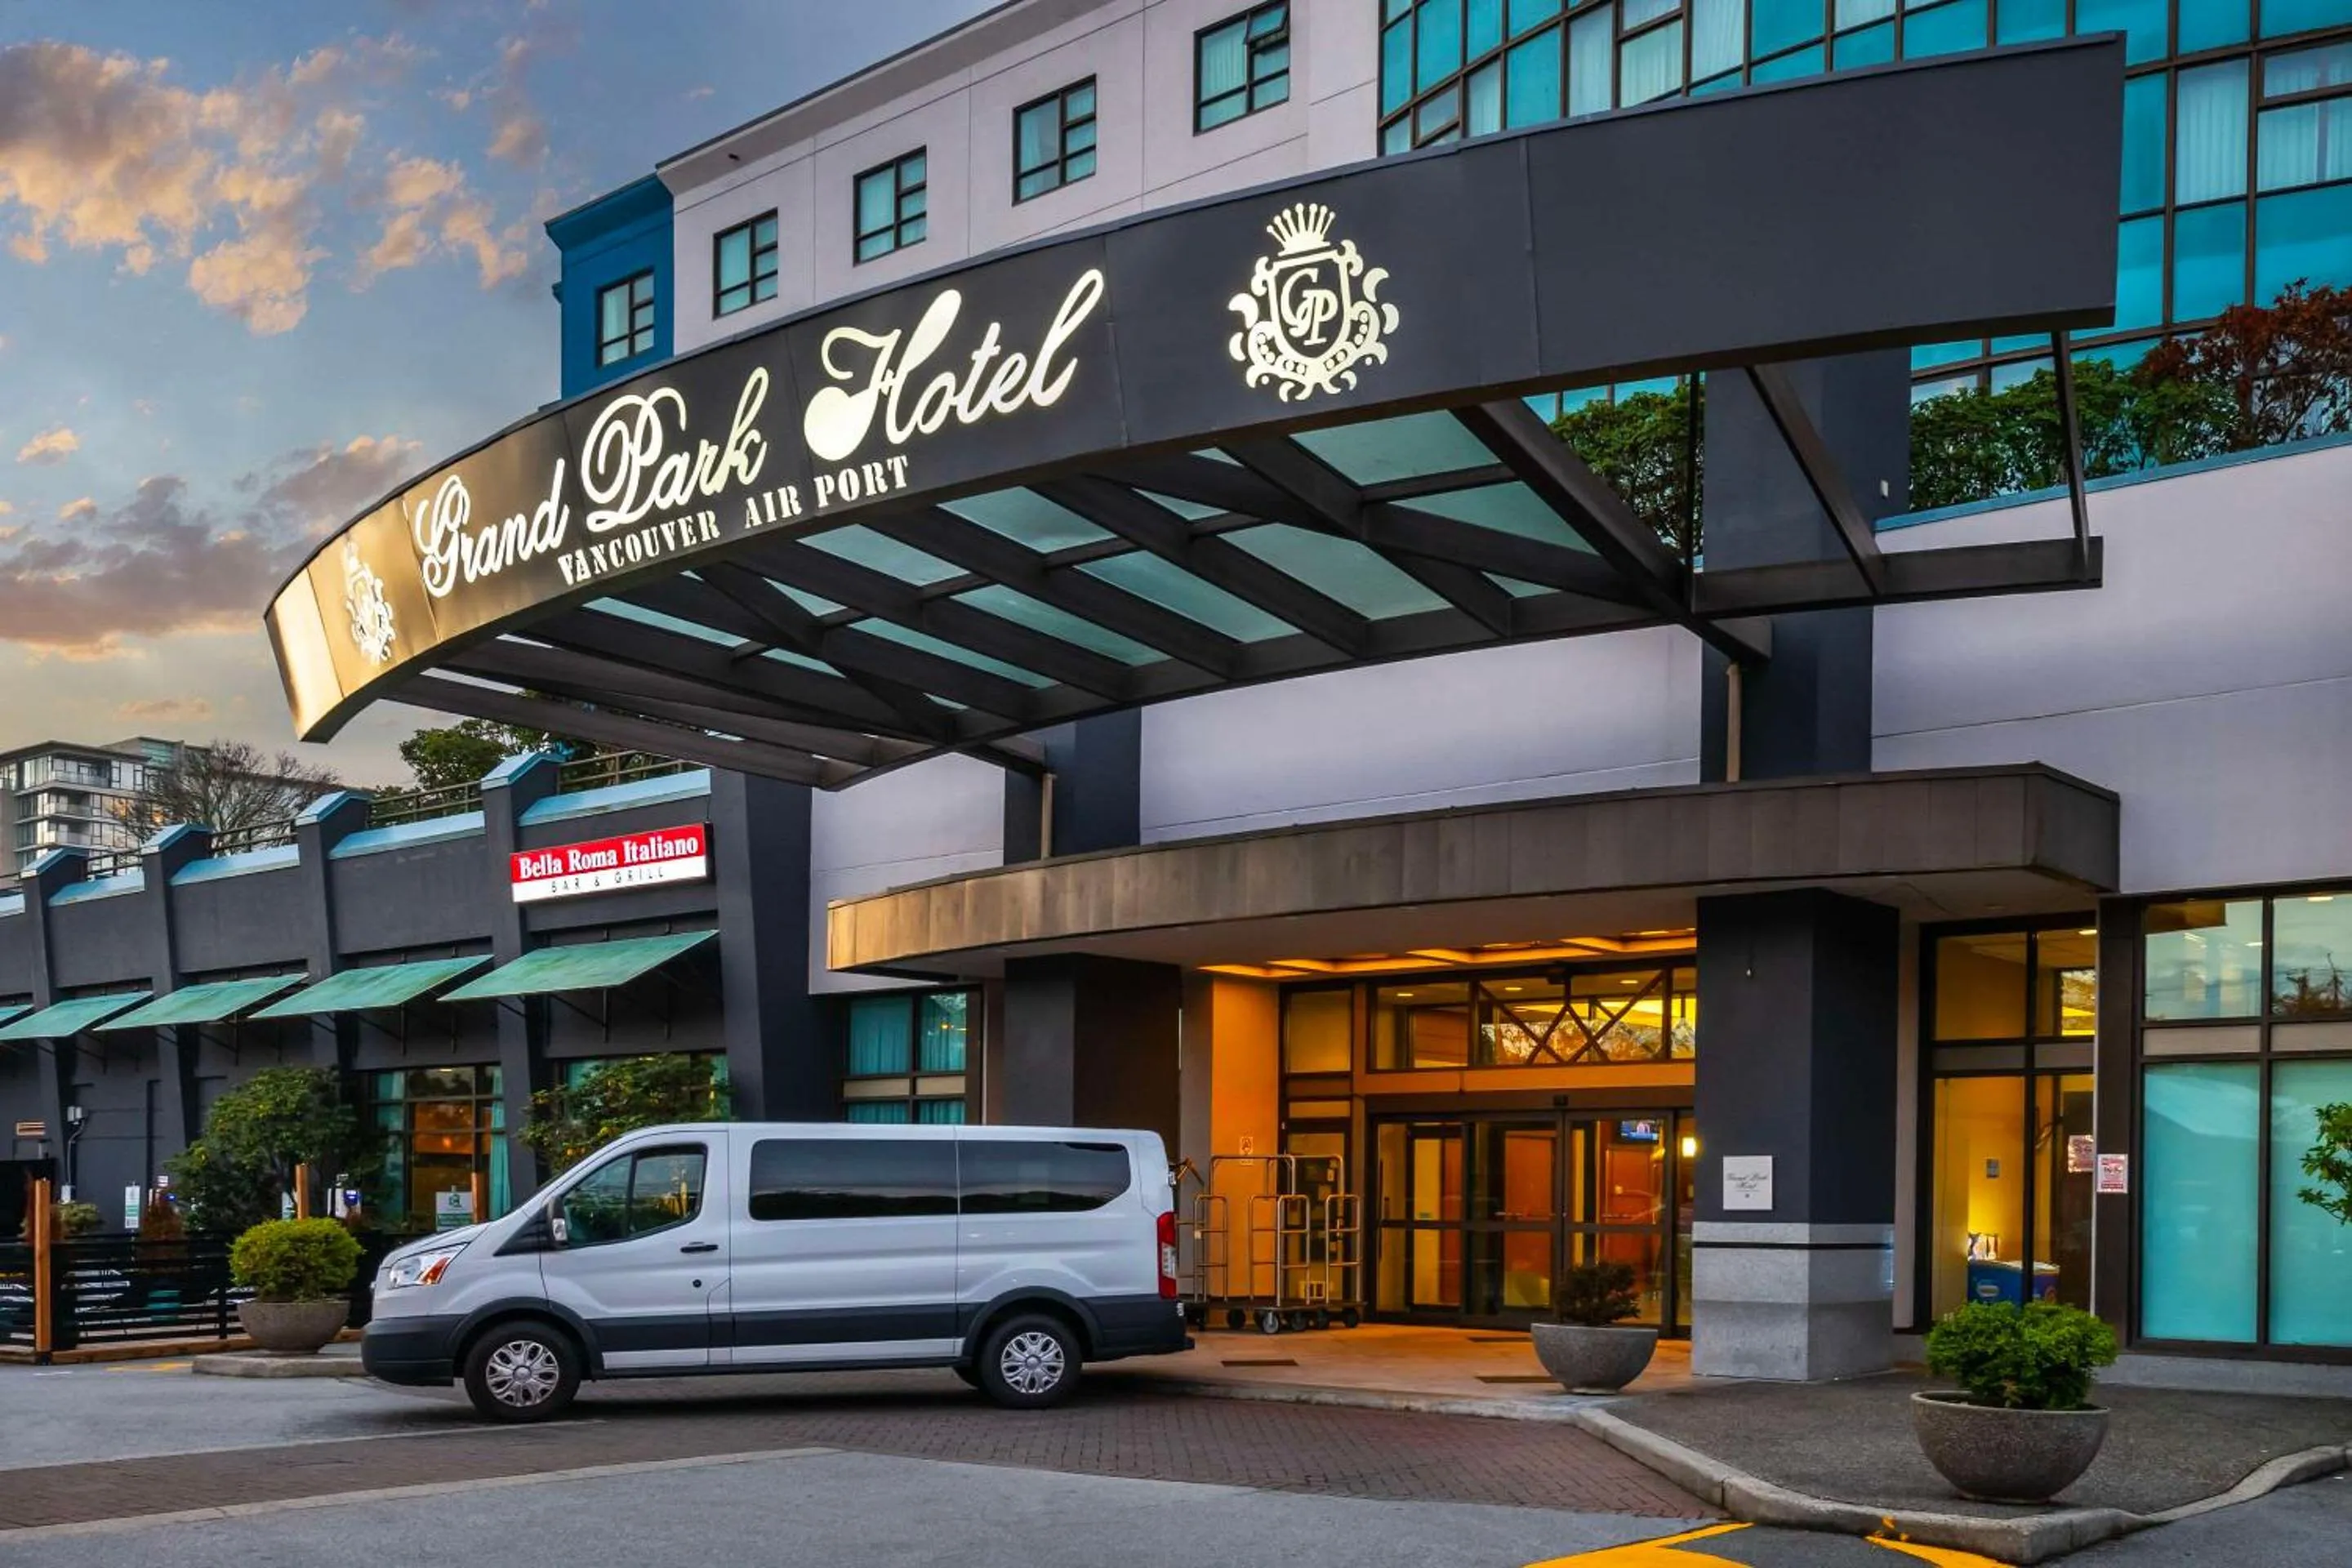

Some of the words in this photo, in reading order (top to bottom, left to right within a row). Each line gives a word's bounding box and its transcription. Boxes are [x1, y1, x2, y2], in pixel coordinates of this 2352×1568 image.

[1280, 267, 1339, 346] GP
[414, 458, 570, 599] Grand
[581, 367, 769, 532] Park
[804, 269, 1104, 461] Hotel
[557, 510, 720, 586] VANCOUVER
[744, 485, 803, 529] AIR
[813, 455, 908, 508] PORT
[519, 853, 563, 880] Bella
[568, 849, 618, 872] Roma
[622, 835, 698, 864] Italiano
[614, 866, 664, 883] GRILL
